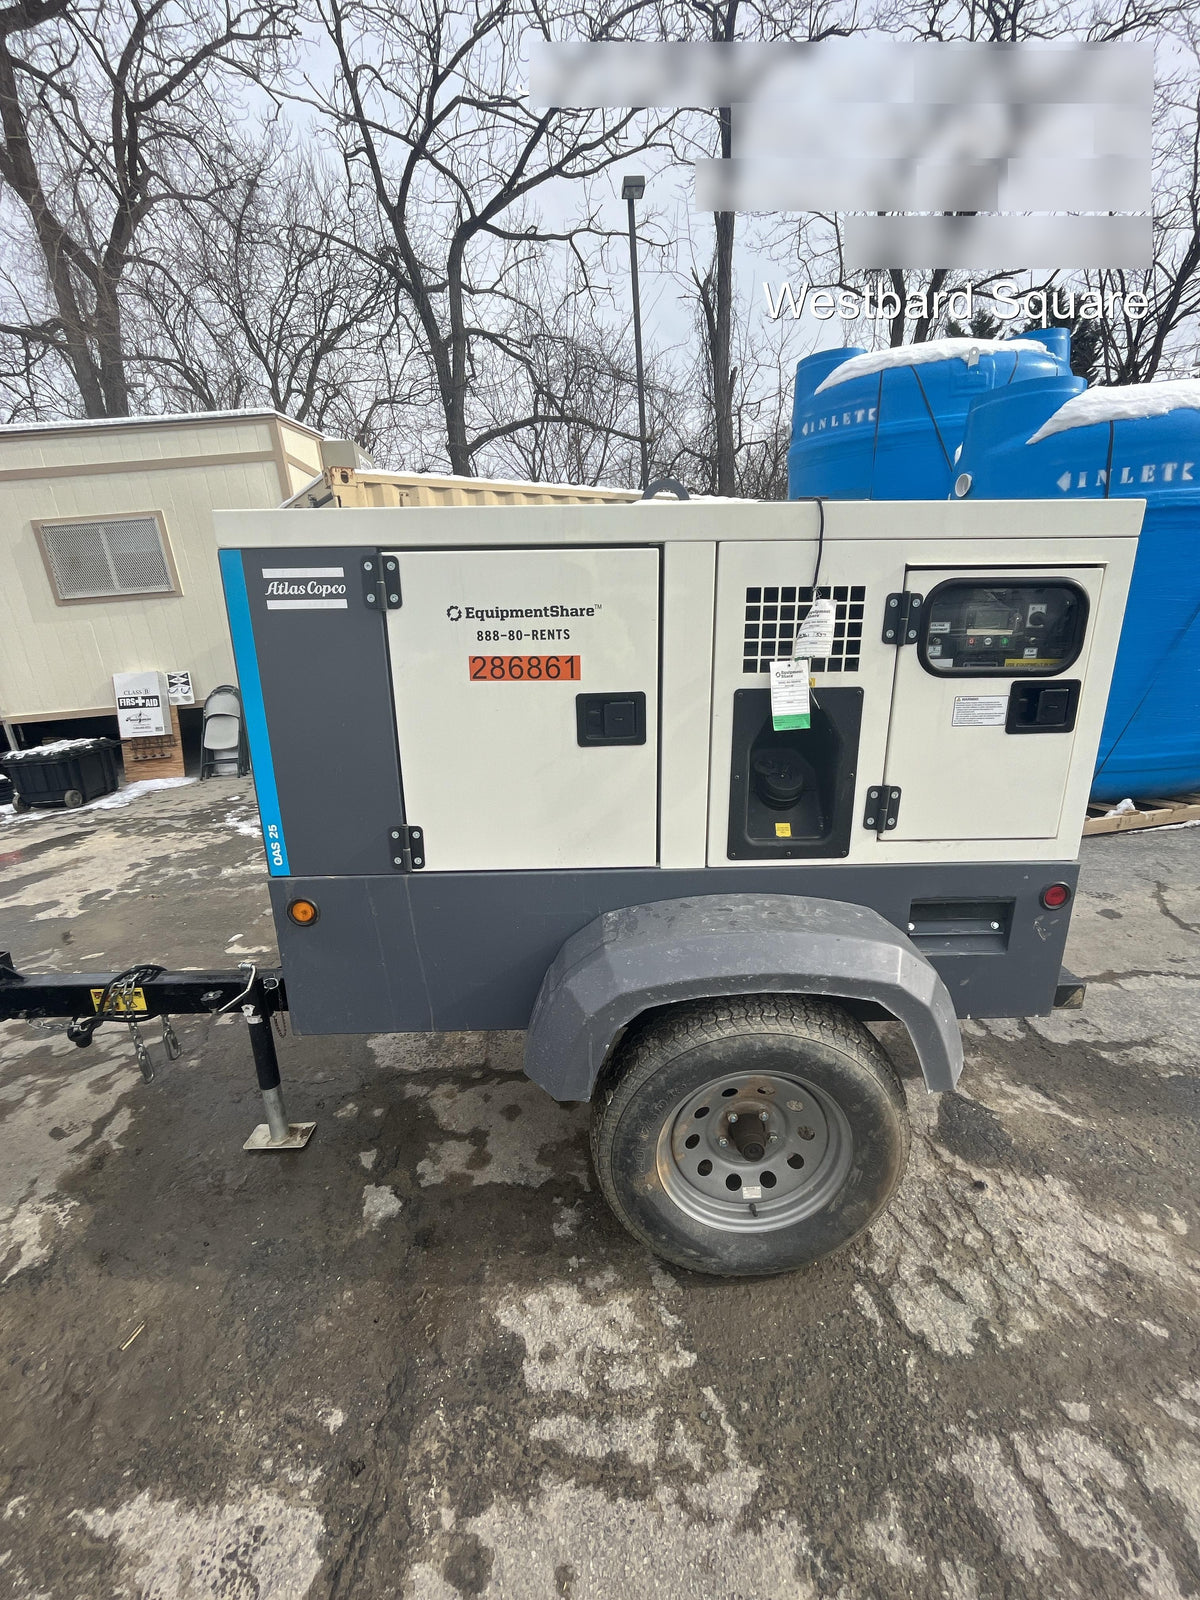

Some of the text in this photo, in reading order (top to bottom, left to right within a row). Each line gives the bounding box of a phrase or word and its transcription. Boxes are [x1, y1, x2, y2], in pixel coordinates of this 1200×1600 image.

[265, 581, 346, 597] Atlas Copco
[477, 628, 570, 641] 888-80-RENTS
[471, 655, 576, 680] 286861
[267, 824, 279, 839] 25
